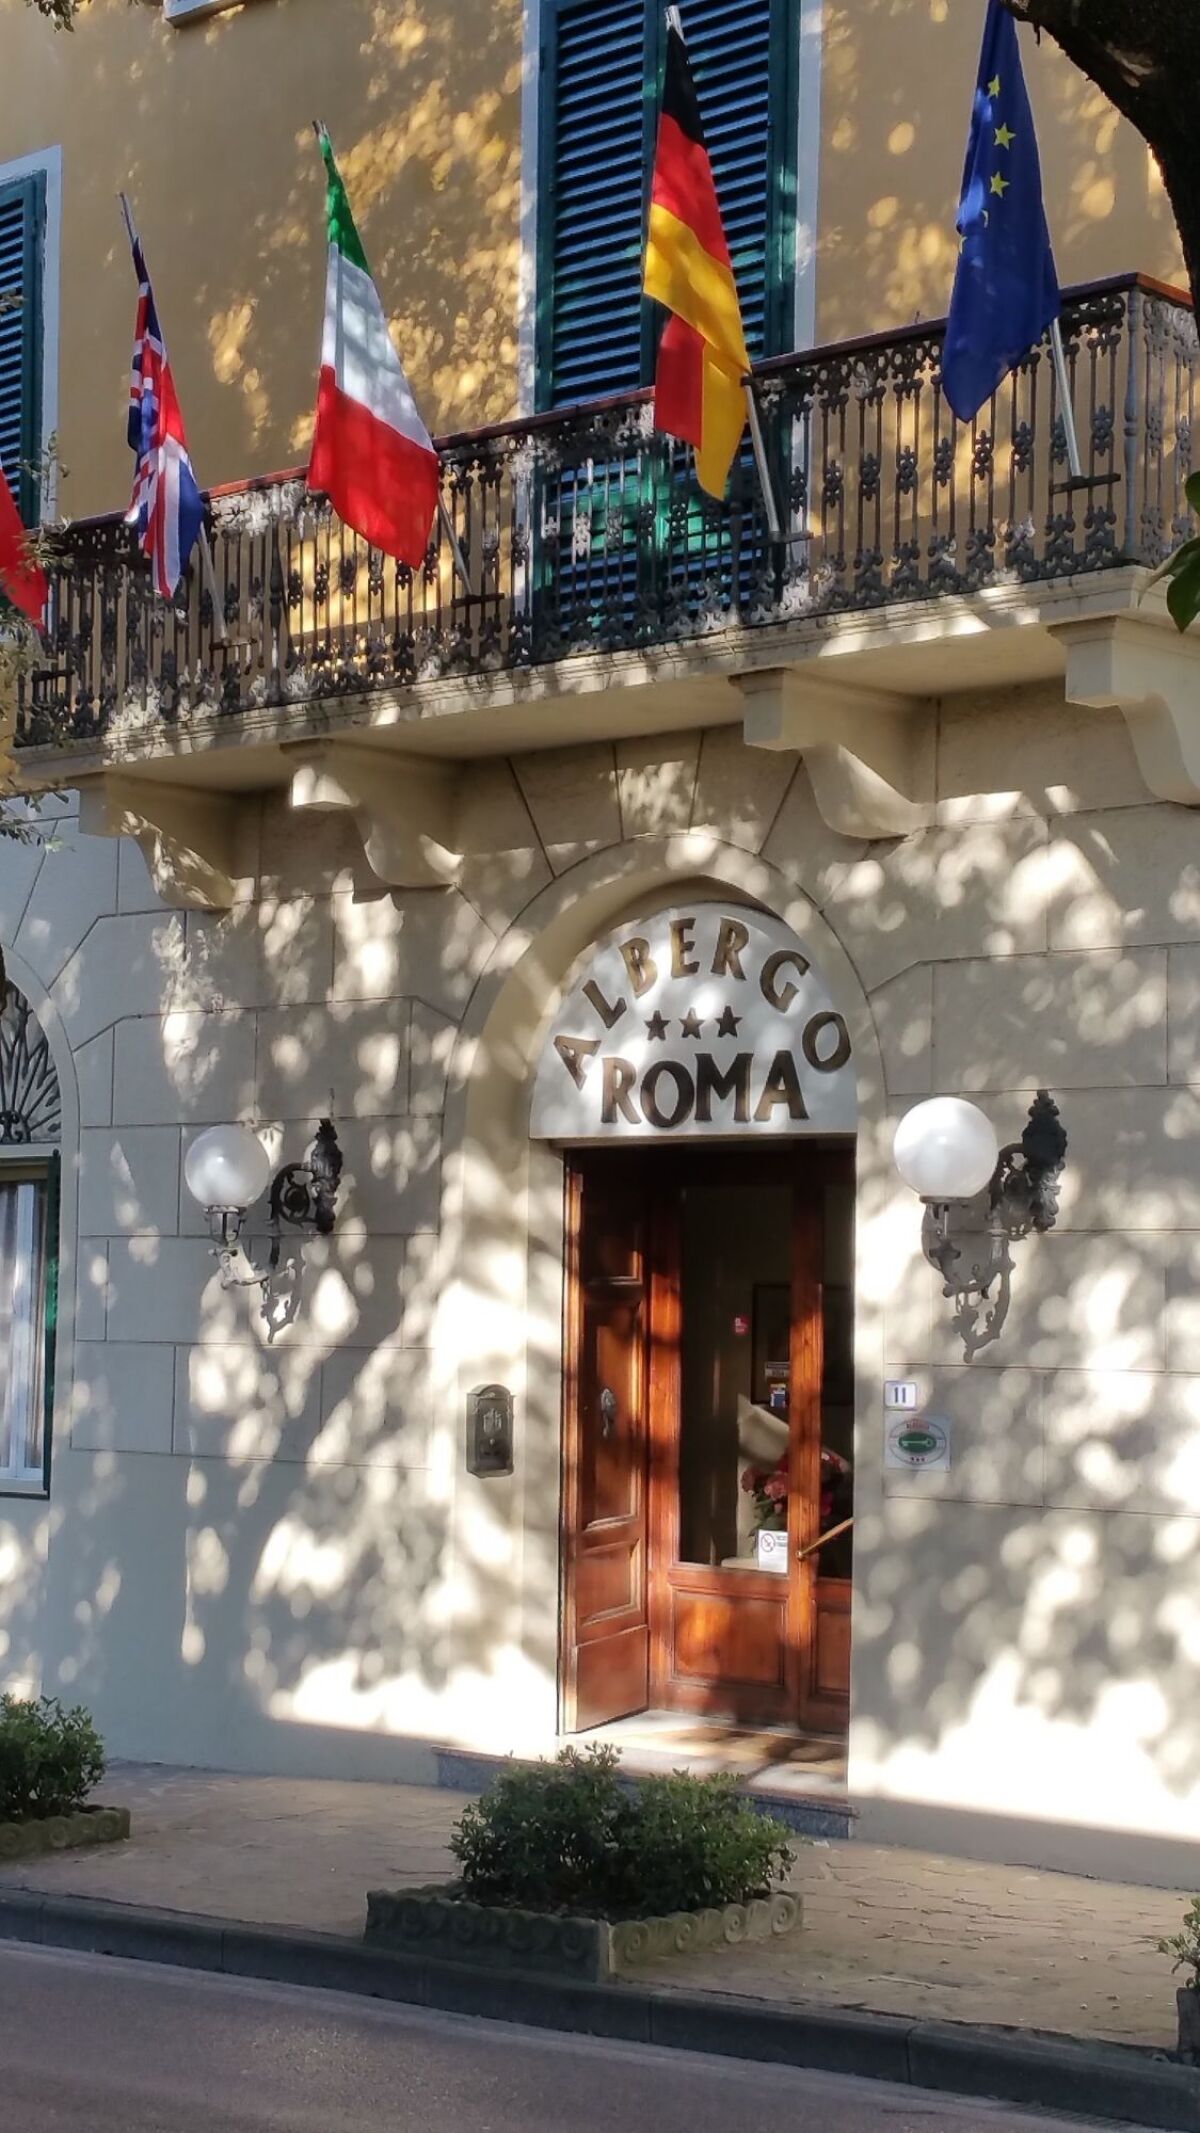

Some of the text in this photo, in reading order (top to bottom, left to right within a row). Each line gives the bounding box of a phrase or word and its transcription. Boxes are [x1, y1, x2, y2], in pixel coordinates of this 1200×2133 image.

[553, 916, 851, 1090] ALBERGO
[600, 1050, 810, 1128] ROMA
[894, 1386, 907, 1404] 11
